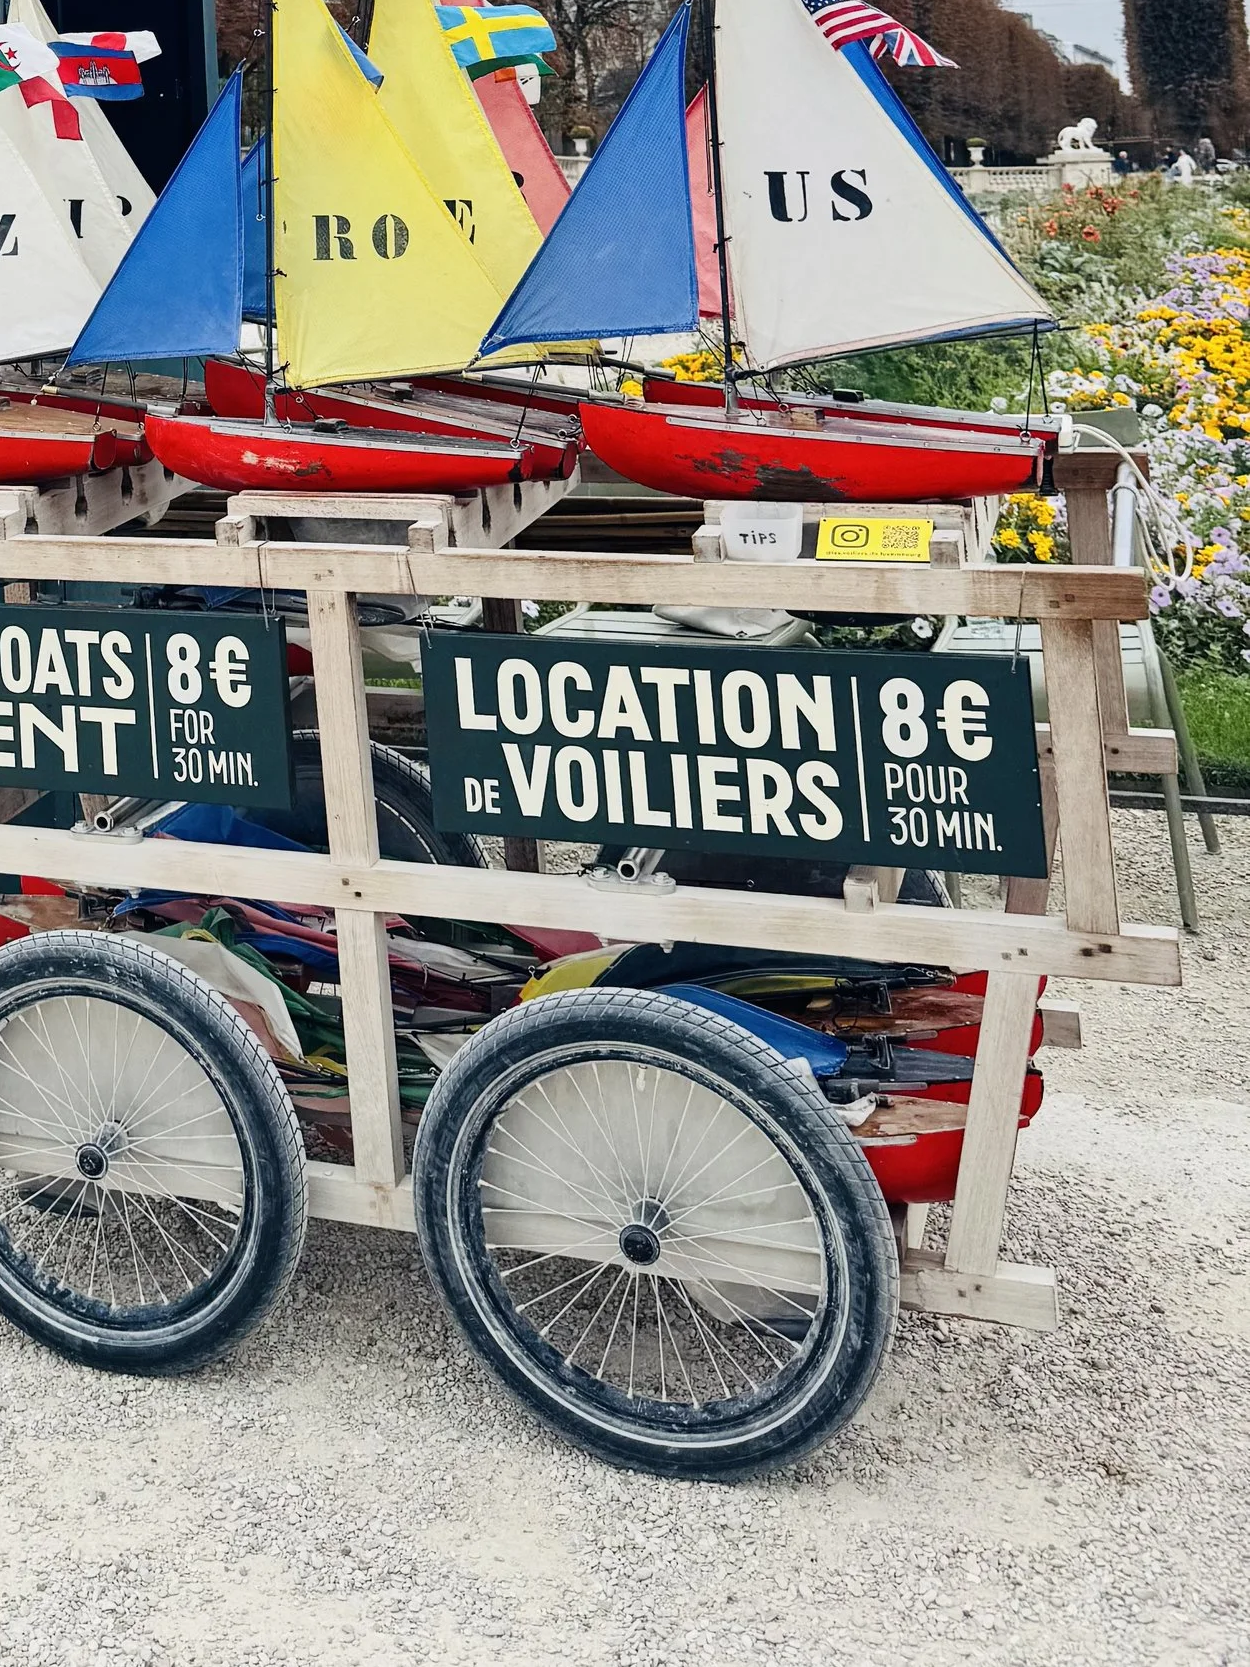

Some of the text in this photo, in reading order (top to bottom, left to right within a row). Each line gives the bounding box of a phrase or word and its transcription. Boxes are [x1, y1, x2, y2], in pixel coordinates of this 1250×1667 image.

[763, 168, 873, 223] US
[311, 213, 410, 261] RO
[169, 708, 216, 745] FOR
[454, 657, 837, 752] LOCATION
[171, 747, 259, 787] 30 MIN.
[883, 762, 970, 805] POUR
[463, 742, 844, 841] DE VOILIERS
[887, 806, 1003, 852] 30 MIN.
